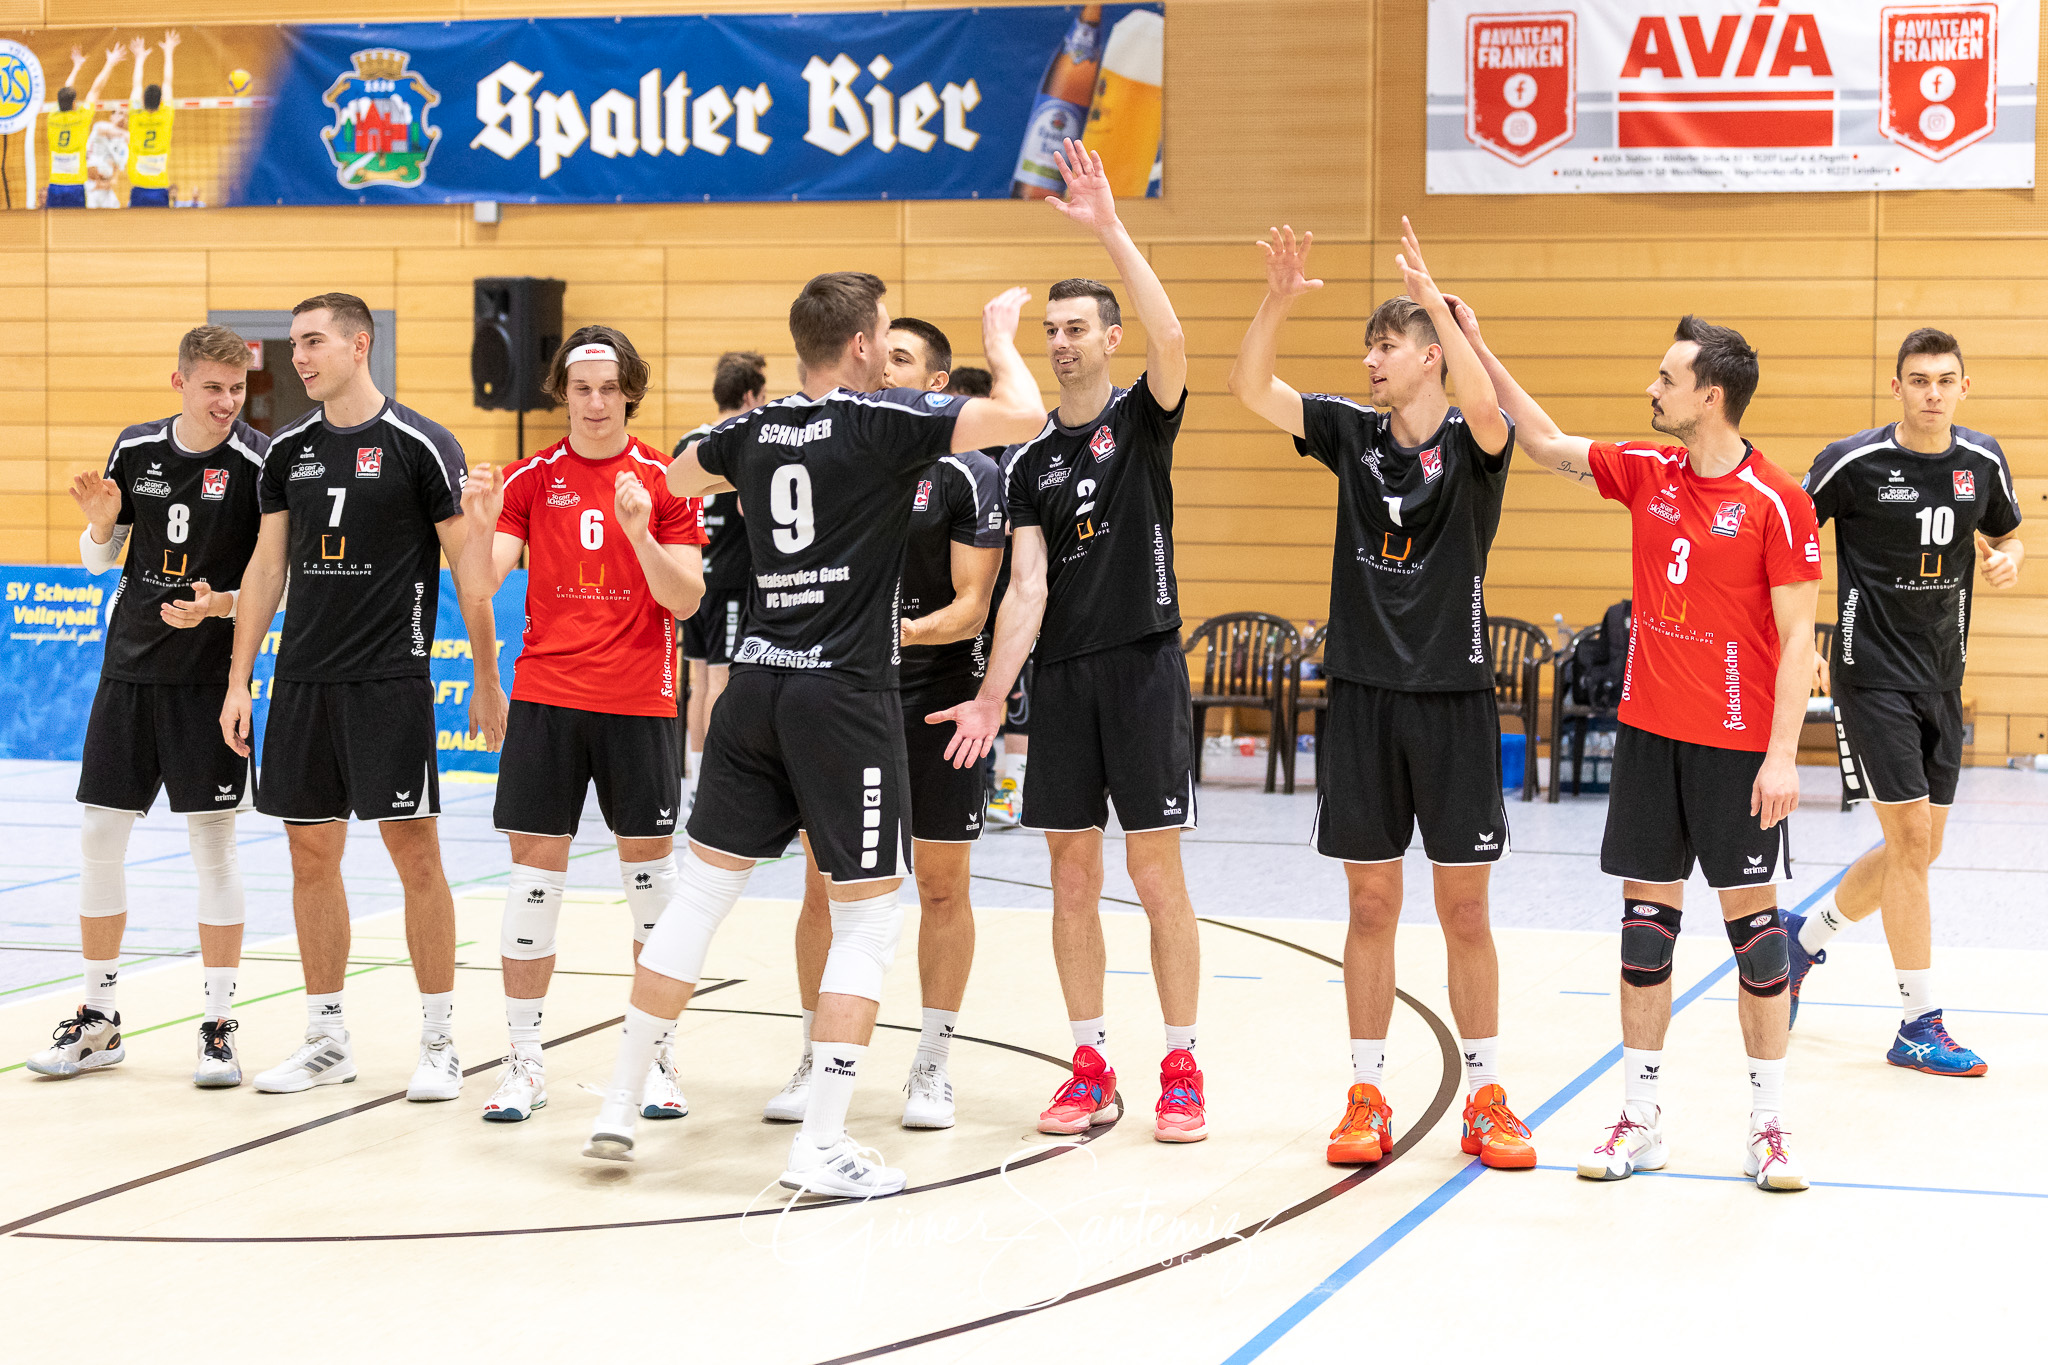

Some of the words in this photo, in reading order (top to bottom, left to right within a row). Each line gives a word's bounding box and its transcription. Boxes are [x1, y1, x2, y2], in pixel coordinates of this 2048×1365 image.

[1479, 25, 1564, 47] #AVIATEAM
[1619, 0, 1834, 79] AVIA
[1894, 17, 1985, 40] #AVIATEAM
[1477, 46, 1564, 69] FRANKEN
[1893, 38, 1984, 63] FRANKEN
[469, 60, 773, 179] Spalter
[801, 52, 982, 157] Bier
[143, 130, 157, 149] 2
[326, 487, 347, 527] 7
[770, 463, 815, 554] 9
[1075, 478, 1097, 516] 2
[166, 503, 190, 544] 8
[579, 508, 605, 551] 6
[1915, 505, 1955, 546] 10
[1666, 537, 1691, 585] 3
[819, 565, 851, 583] Gust
[5, 581, 32, 602] SV
[33, 582, 104, 608] Schwaig
[13, 605, 99, 630] Volleyball
[1468, 575, 1486, 664] Feldschlößchen
[1722, 641, 1747, 731] Feldschlößchen
[214, 793, 238, 803] erima
[391, 799, 415, 809] erima
[656, 817, 674, 827] erima
[1163, 807, 1182, 817] erima
[1474, 842, 1499, 852] erima
[1743, 865, 1769, 875] erima
[321, 1008, 343, 1016] erima
[824, 1065, 856, 1078] erima
